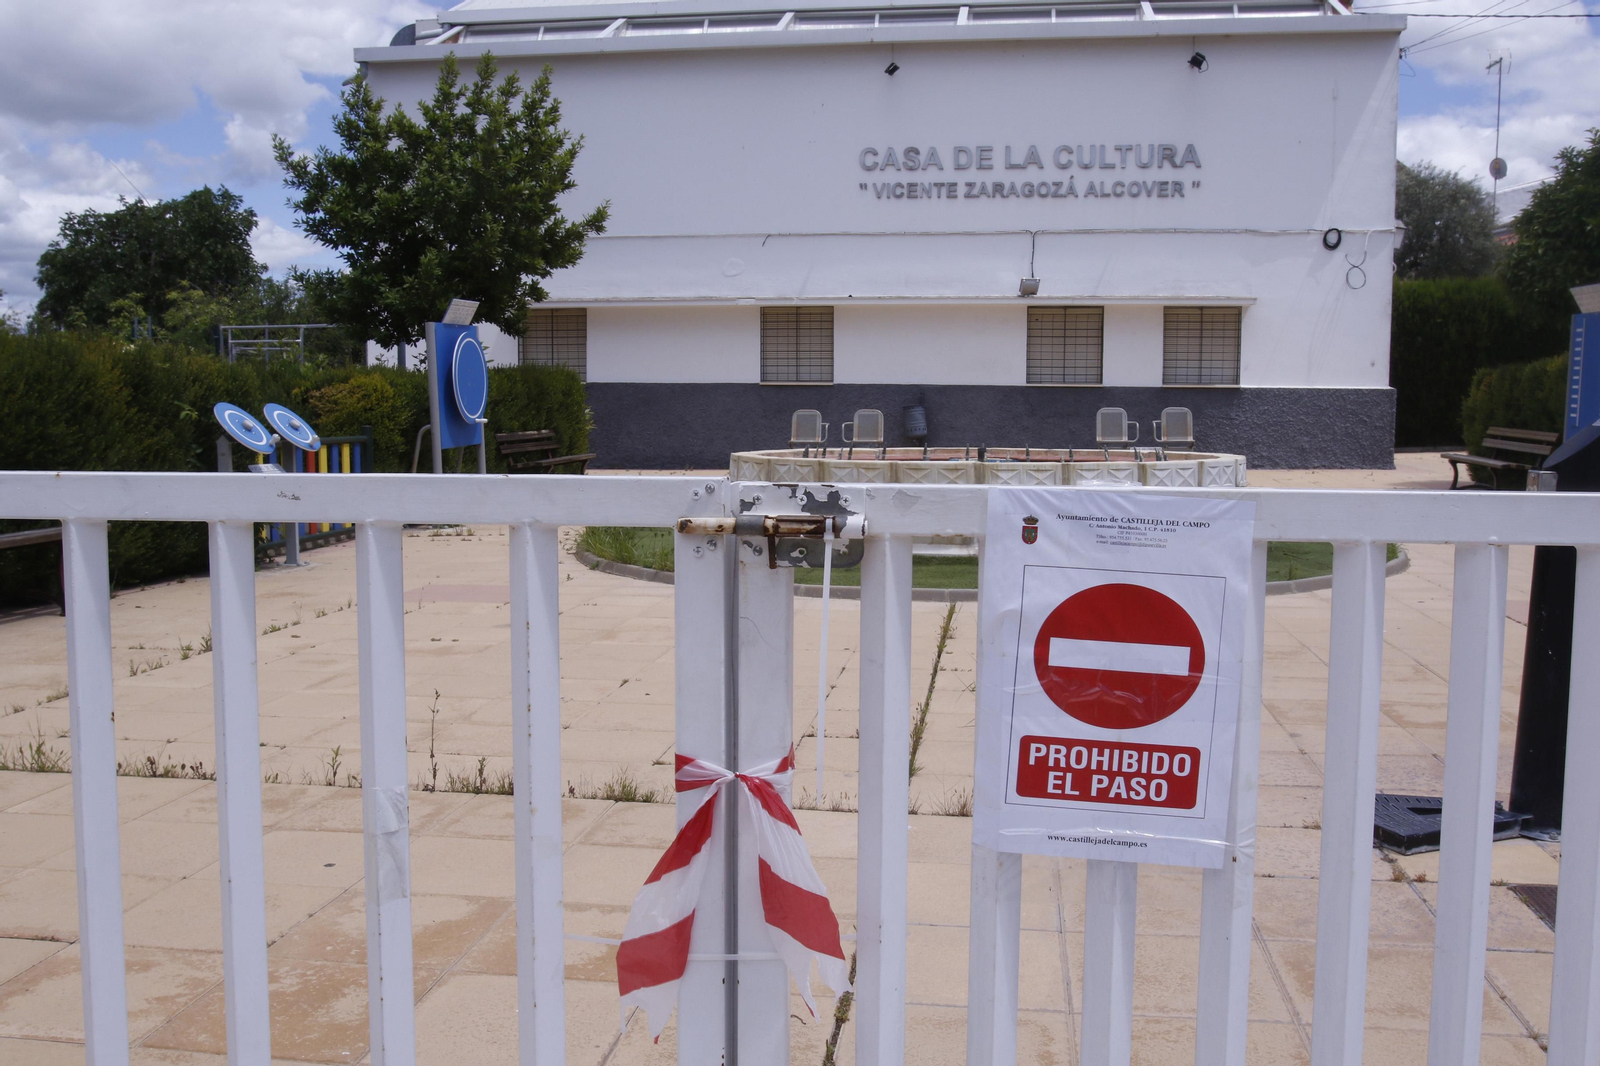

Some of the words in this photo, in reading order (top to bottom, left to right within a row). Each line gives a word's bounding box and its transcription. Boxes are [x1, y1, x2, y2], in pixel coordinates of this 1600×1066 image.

[859, 146, 944, 171] CASA
[953, 145, 994, 170] DE
[1005, 144, 1044, 170] LA
[1053, 143, 1202, 170] CULTURA
[963, 175, 1079, 199] ZARAGOZÁ
[1056, 513, 1108, 522] Ayuntamiento
[1120, 516, 1164, 526] CASTILLEJA
[1165, 519, 1181, 527] DEL
[1182, 520, 1211, 529] CAMPO
[1028, 743, 1192, 777] PROHIBIDO
[1047, 771, 1080, 796] EL
[1090, 774, 1168, 802] PASO
[1047, 834, 1148, 849] www.castillejadelcampo.es
